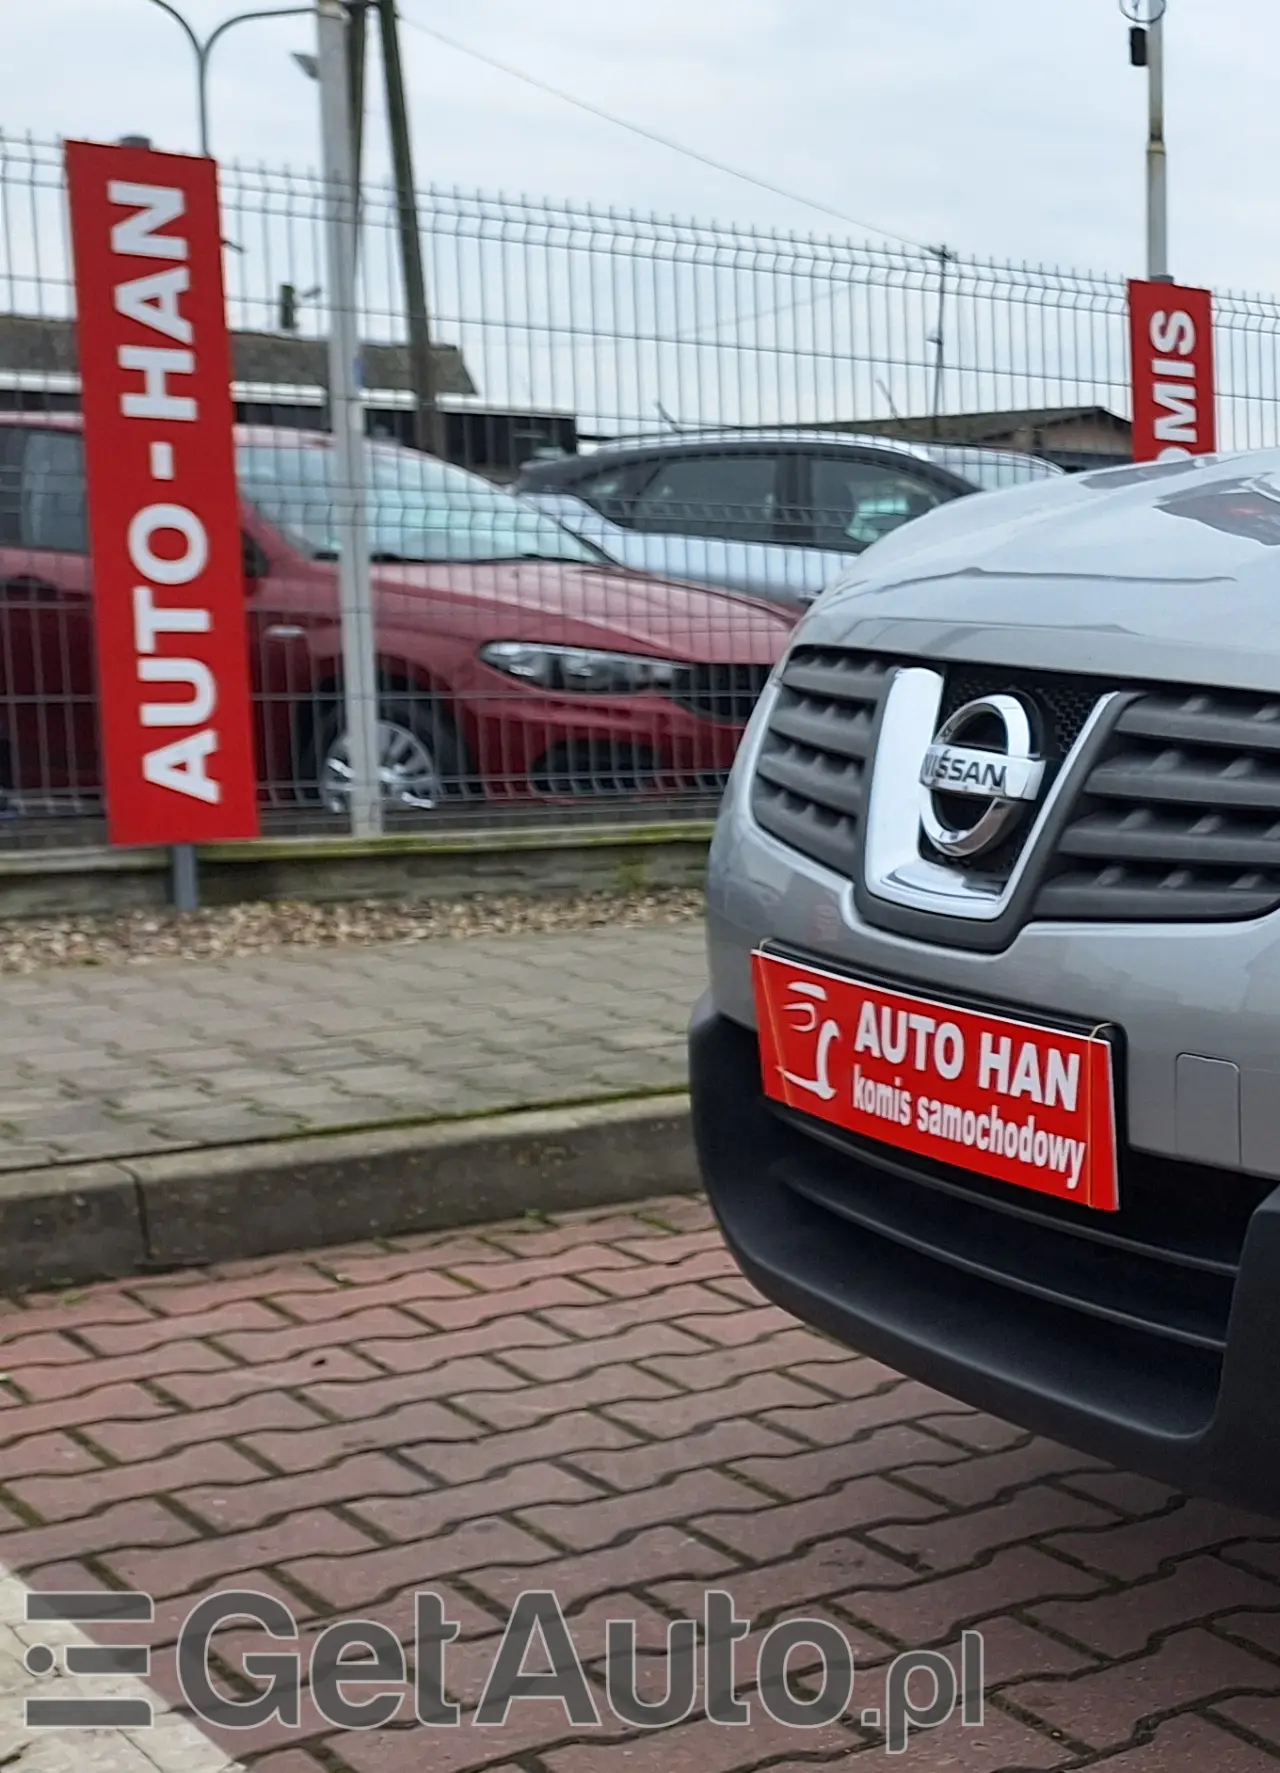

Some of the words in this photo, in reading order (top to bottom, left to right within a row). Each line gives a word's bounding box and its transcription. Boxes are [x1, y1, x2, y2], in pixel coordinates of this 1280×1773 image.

[109, 181, 198, 421] HAN
[129, 503, 220, 804] AUTO
[923, 750, 1007, 789] NISSAN
[854, 1000, 965, 1080] AUTO
[977, 1031, 1081, 1113] HAN
[852, 1063, 912, 1127] komis
[917, 1095, 1085, 1190] samochodowy
